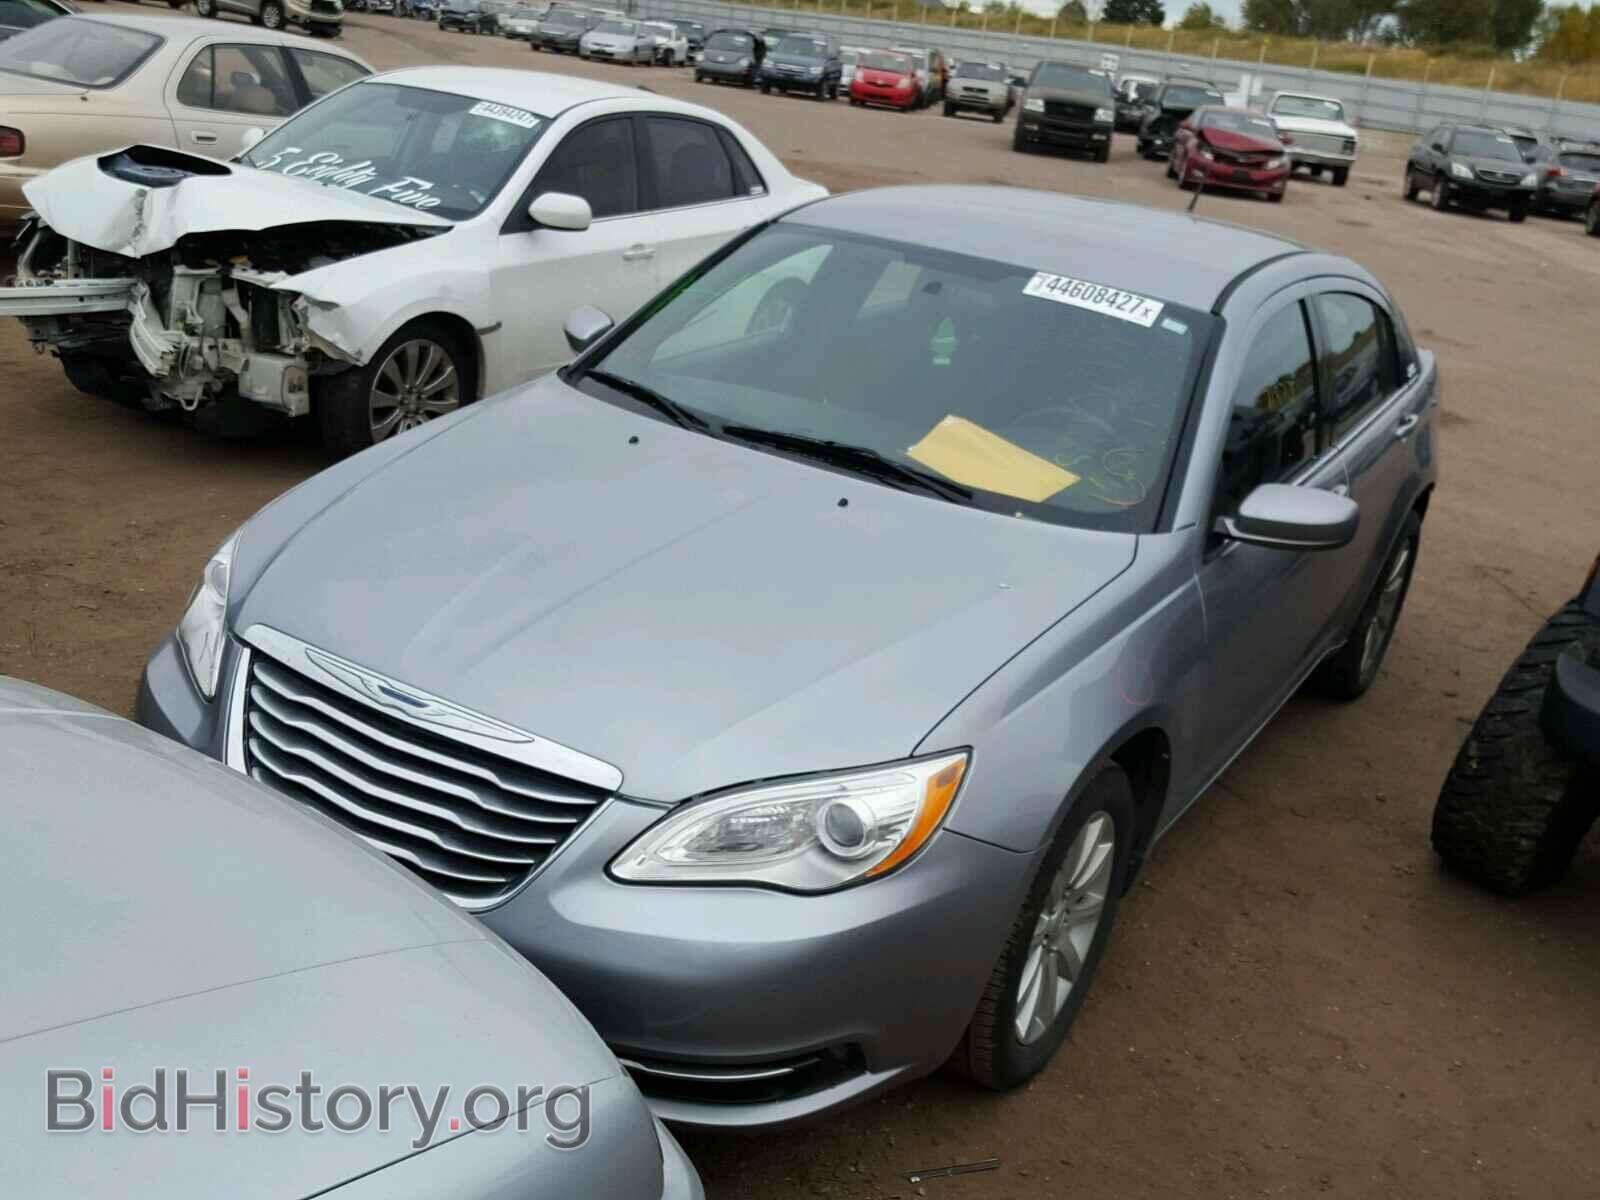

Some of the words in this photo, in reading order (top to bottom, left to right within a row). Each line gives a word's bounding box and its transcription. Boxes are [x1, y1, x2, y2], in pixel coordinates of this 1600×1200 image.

[256, 147, 302, 170] 5
[283, 152, 379, 190] Eighty
[368, 176, 441, 209] Five
